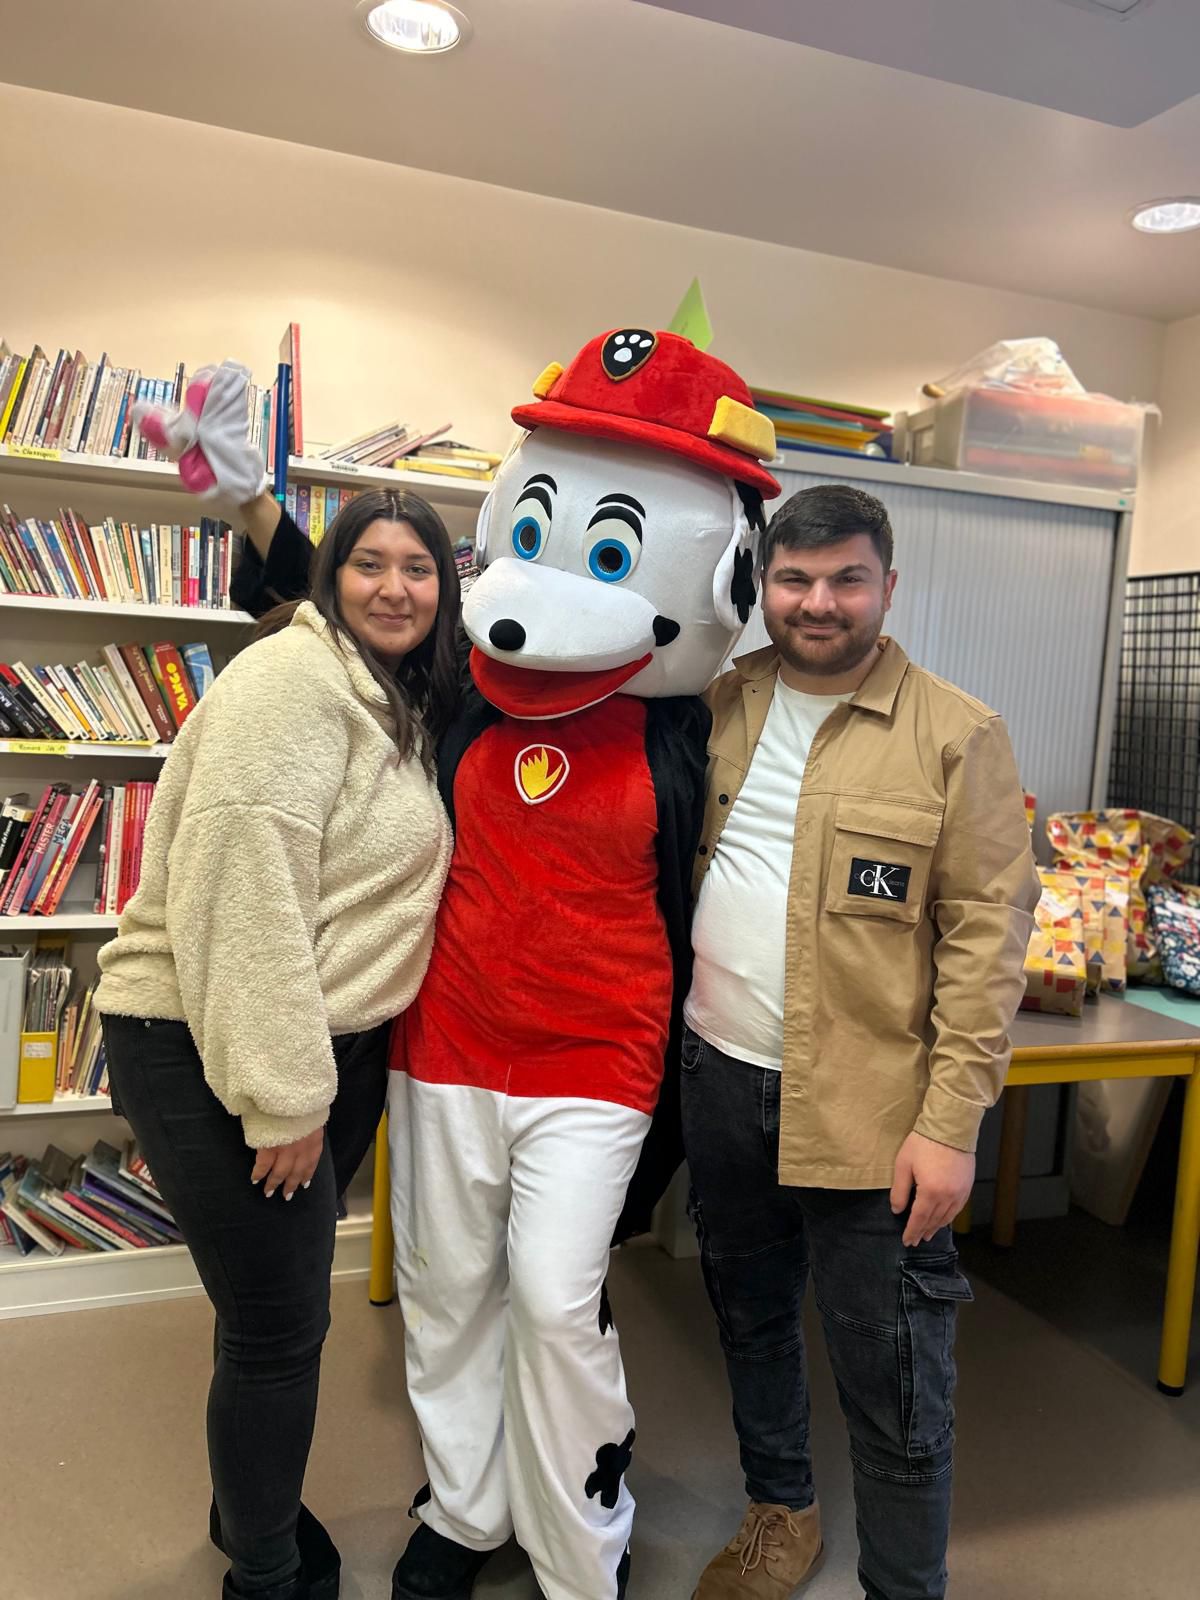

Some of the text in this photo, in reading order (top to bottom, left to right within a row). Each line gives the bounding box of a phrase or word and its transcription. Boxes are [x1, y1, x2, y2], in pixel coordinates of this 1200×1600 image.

[166, 662, 189, 711] VANGO
[3, 820, 13, 836] France
[35, 822, 55, 855] MASTER
